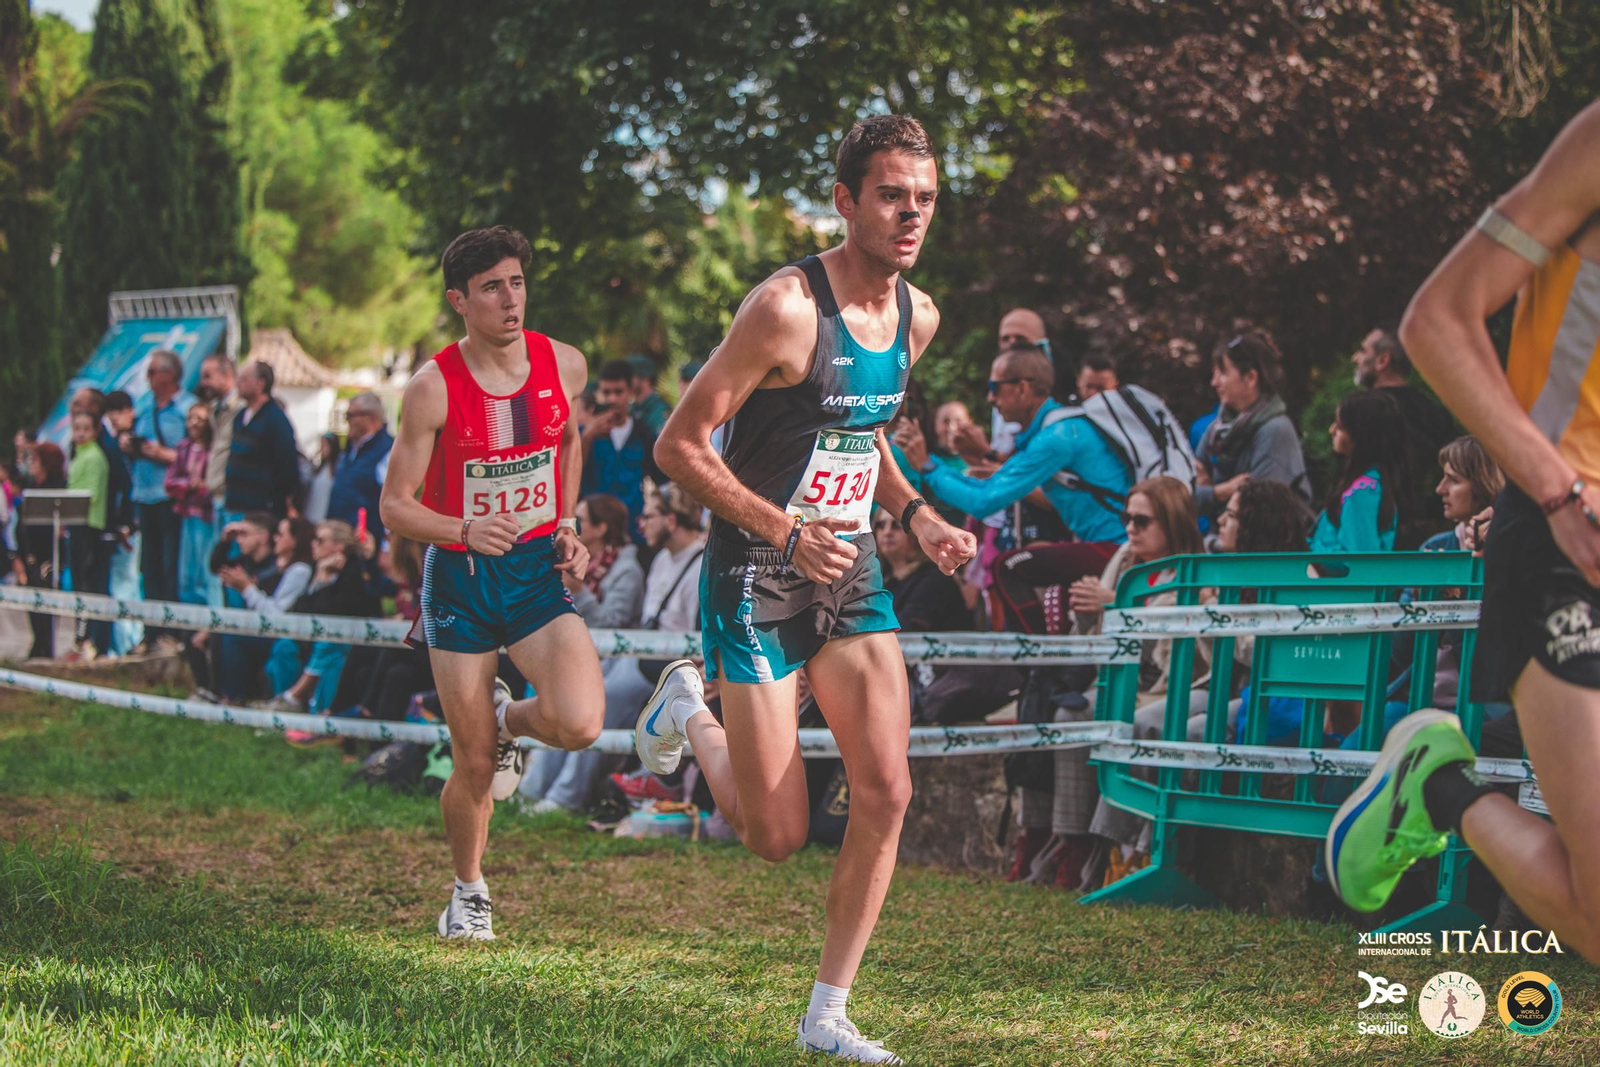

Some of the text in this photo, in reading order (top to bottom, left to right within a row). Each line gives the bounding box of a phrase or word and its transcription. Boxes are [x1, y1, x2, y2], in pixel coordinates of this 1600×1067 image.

[832, 357, 855, 366] 42K
[491, 460, 534, 476] ITÁLICA
[802, 467, 873, 506] 5130
[472, 481, 548, 517] 5128
[1294, 646, 1341, 659] SEVILLA
